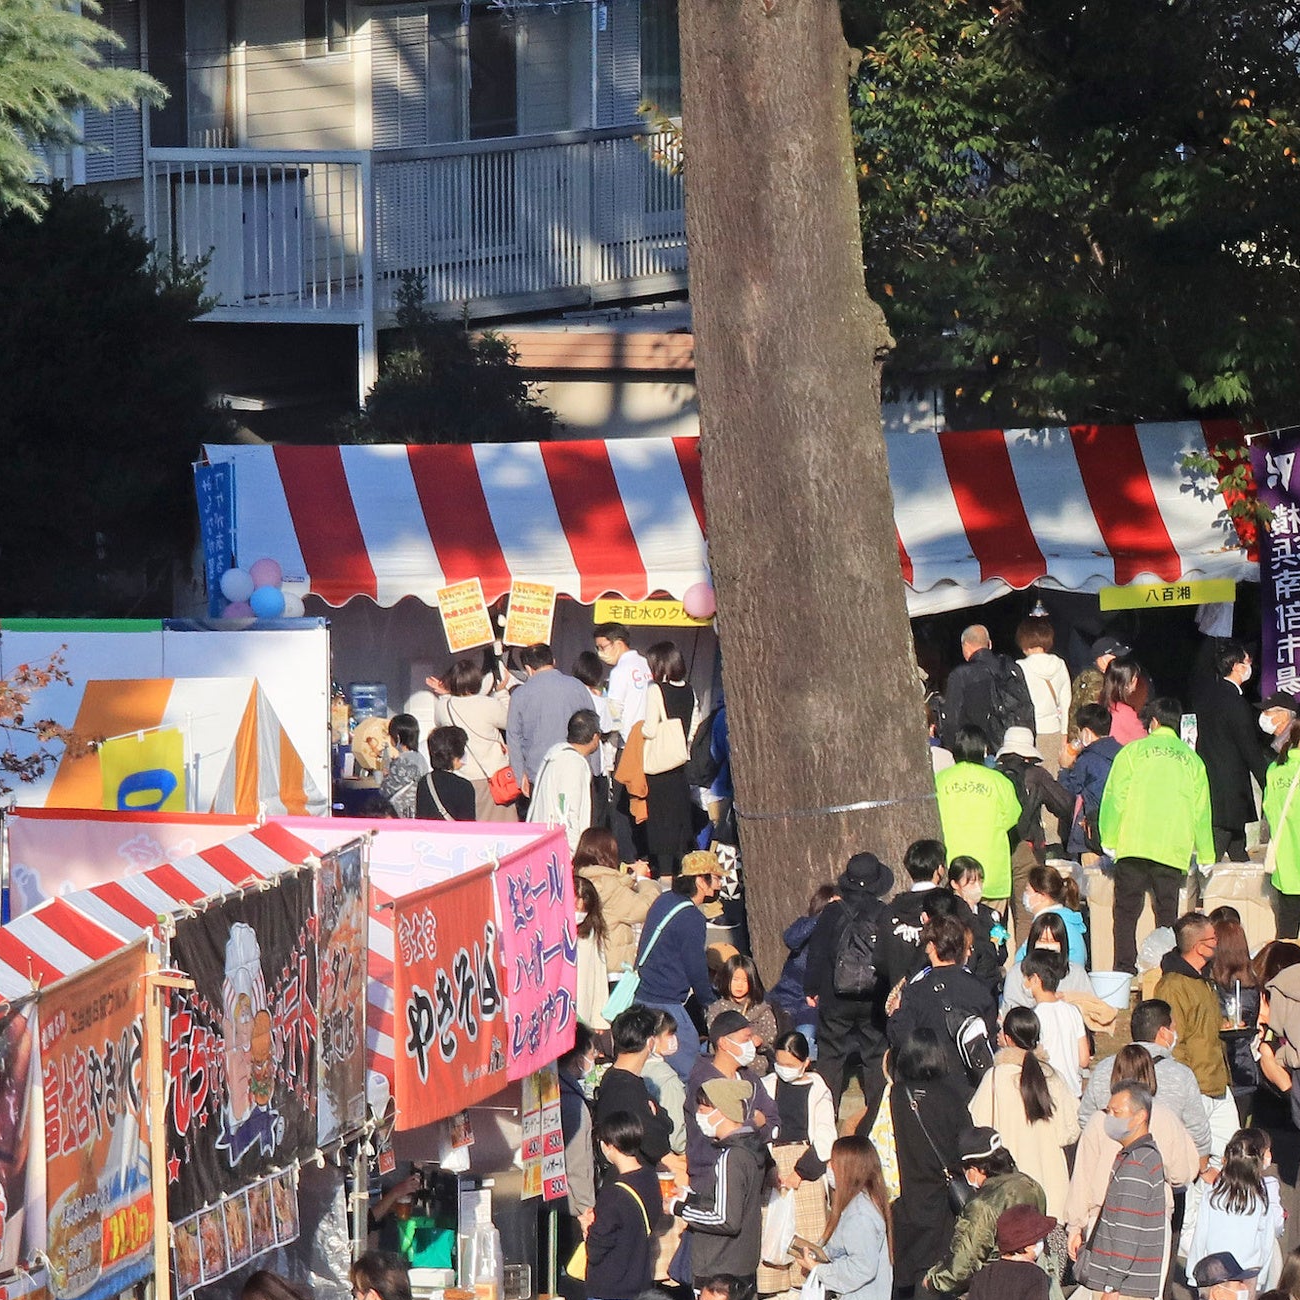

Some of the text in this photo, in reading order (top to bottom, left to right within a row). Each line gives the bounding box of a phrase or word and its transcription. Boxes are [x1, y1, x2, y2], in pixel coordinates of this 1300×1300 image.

[1145, 585, 1191, 603] 八百湘
[405, 919, 502, 1086] やきそば
